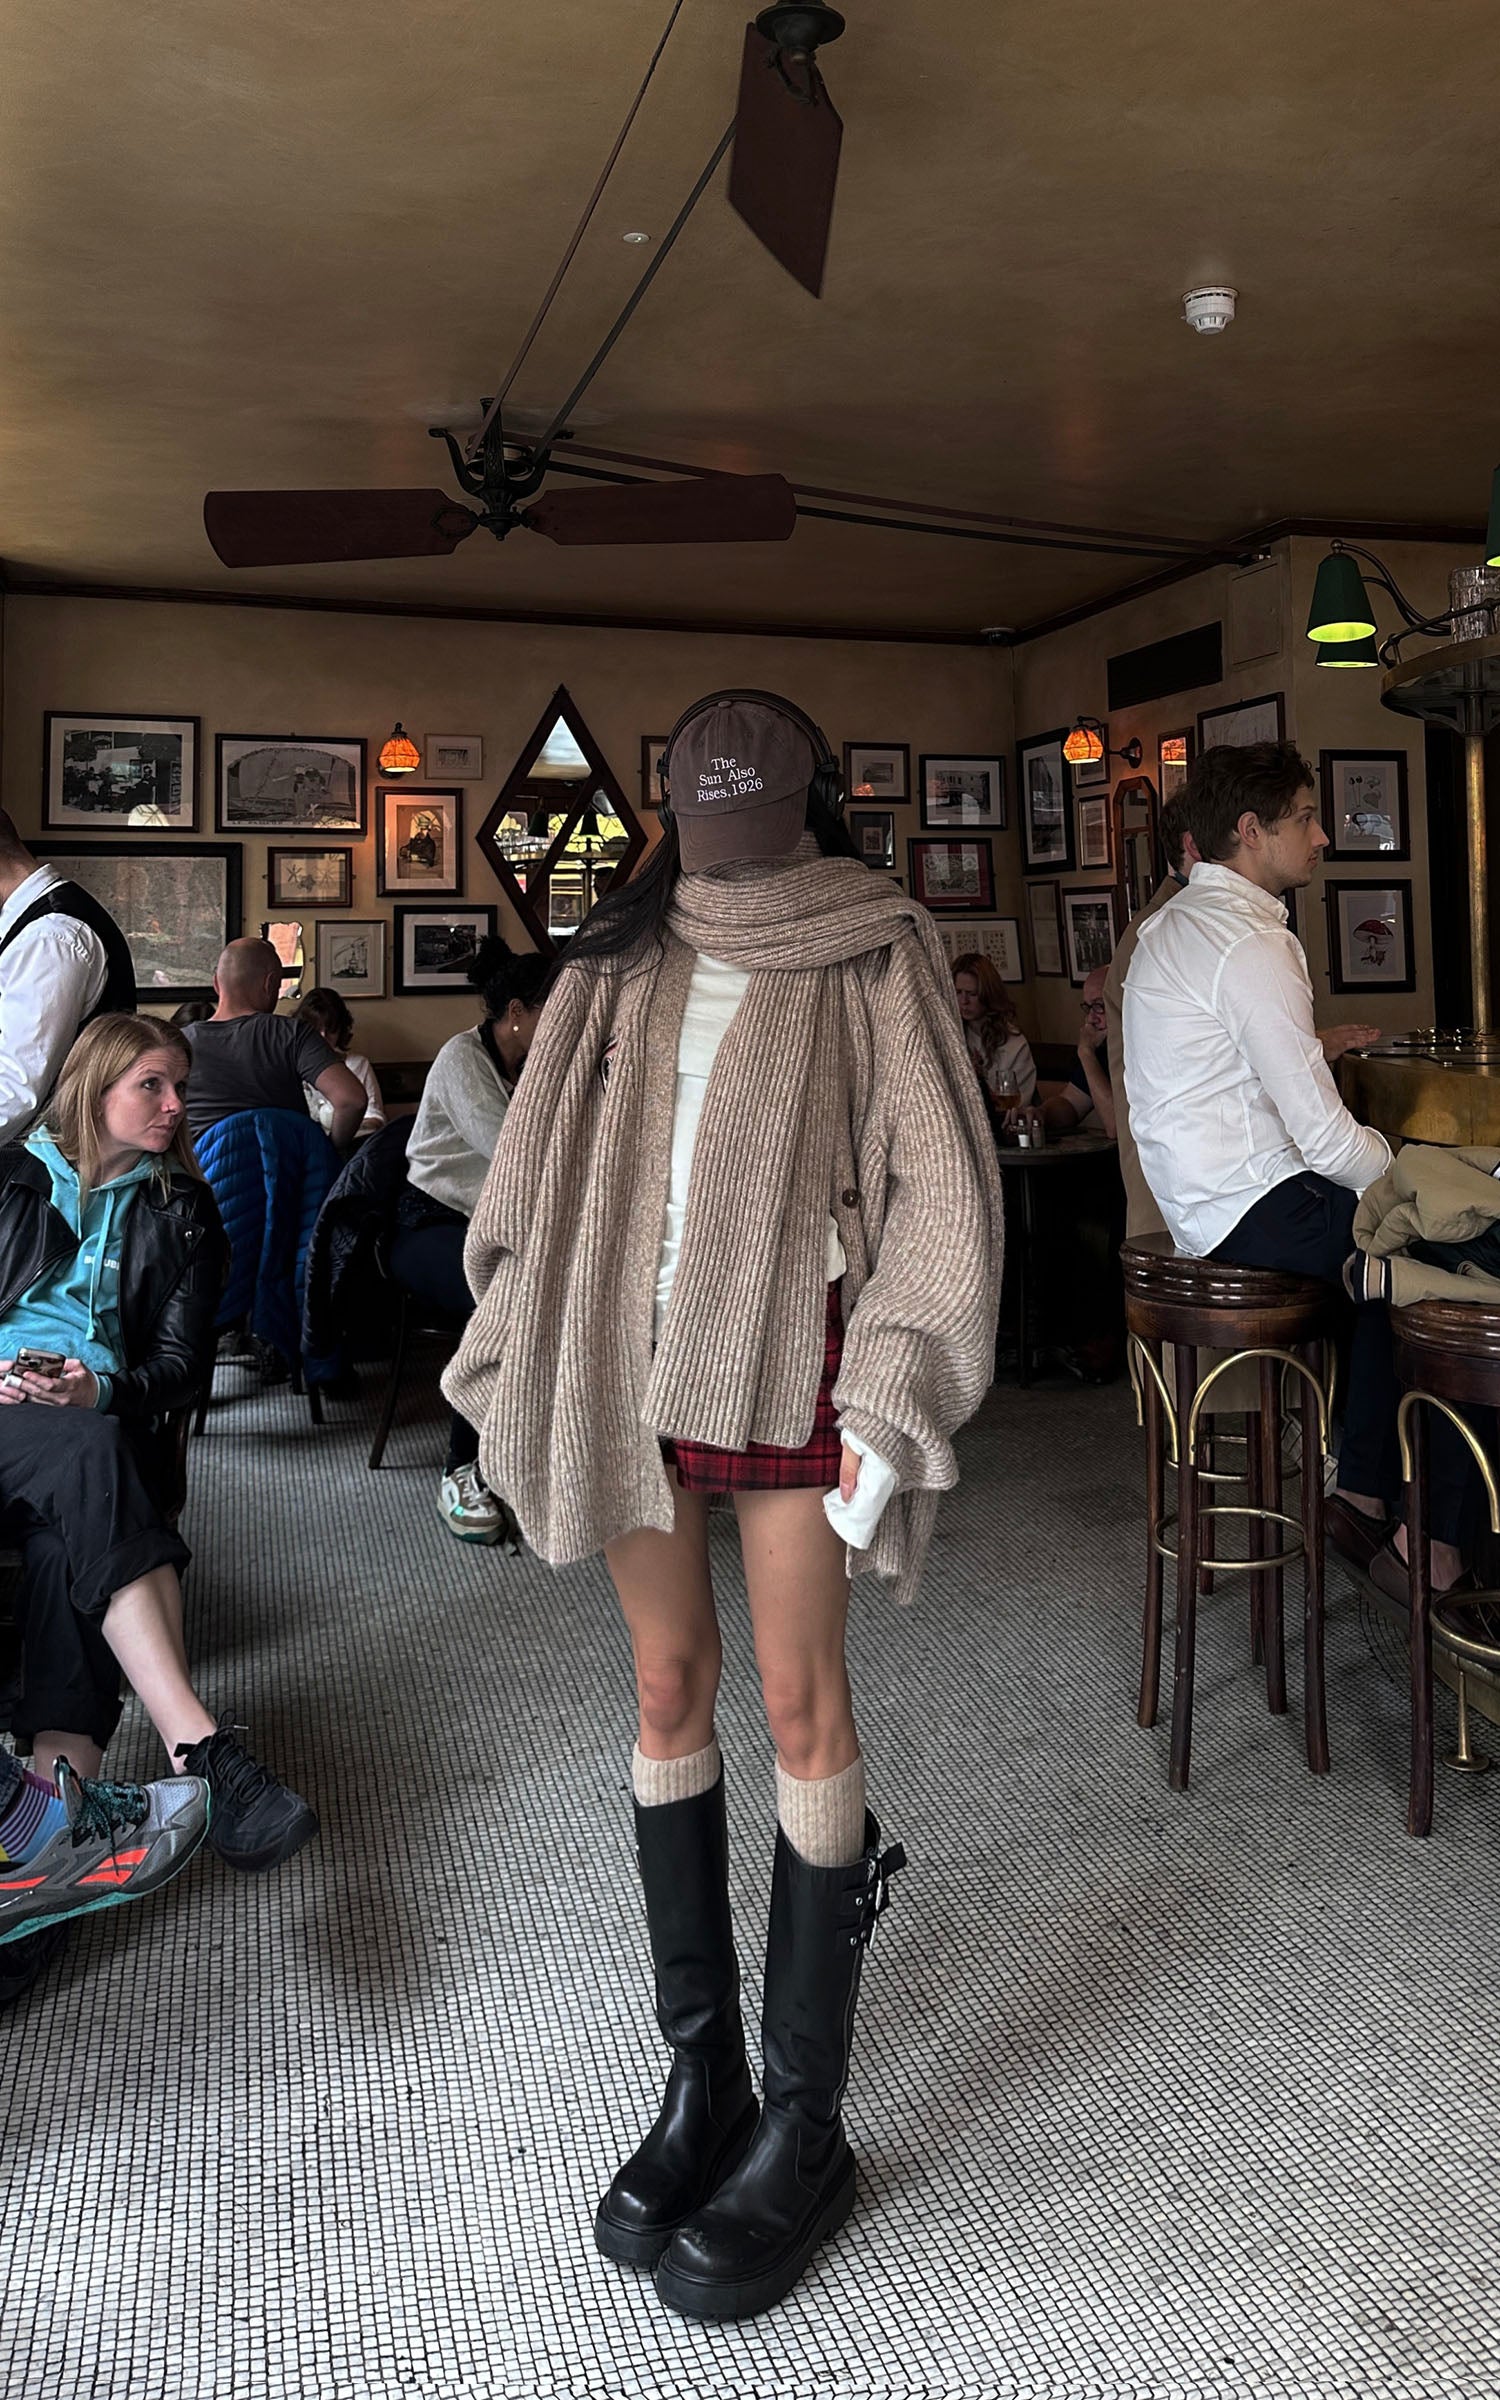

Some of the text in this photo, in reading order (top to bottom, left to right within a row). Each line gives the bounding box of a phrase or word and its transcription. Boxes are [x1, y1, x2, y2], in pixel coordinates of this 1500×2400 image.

[710, 757, 737, 771] The
[699, 767, 756, 787] Sun Also
